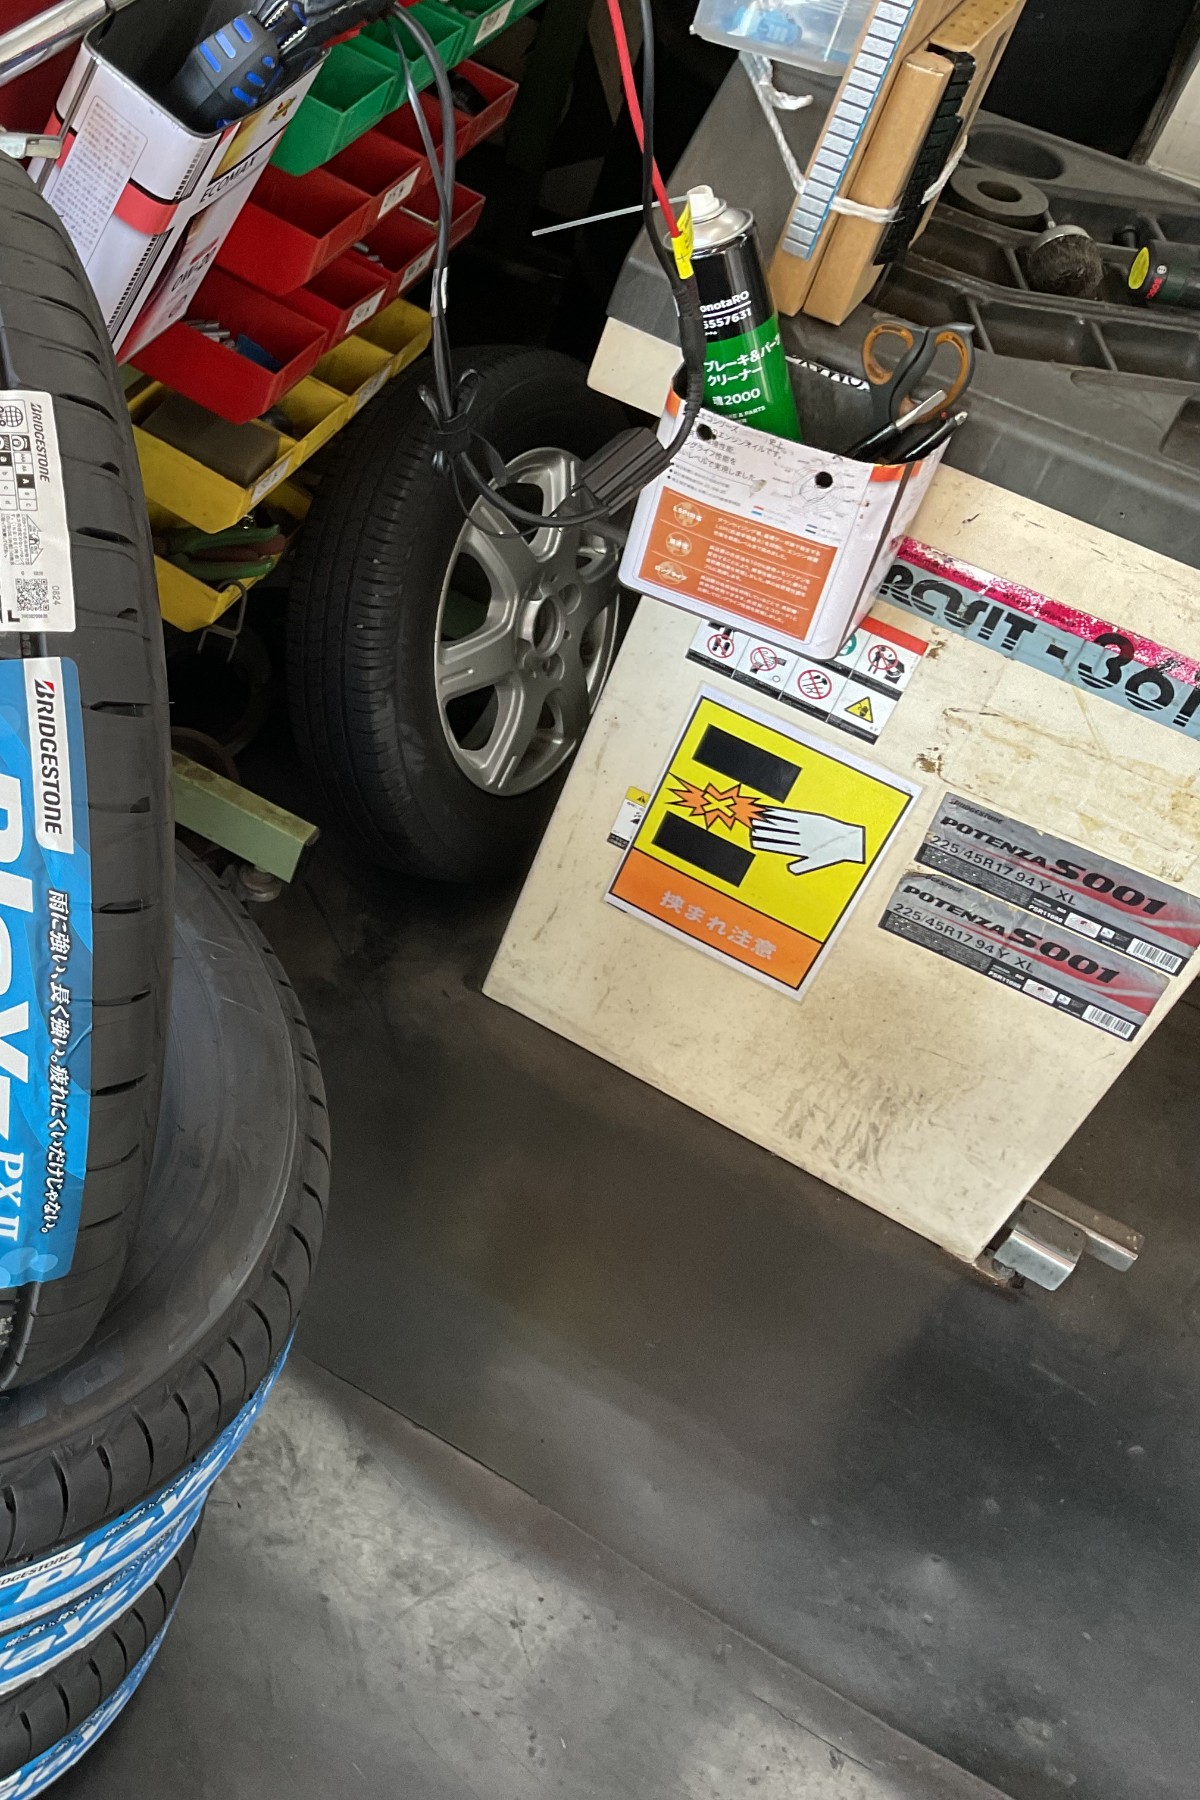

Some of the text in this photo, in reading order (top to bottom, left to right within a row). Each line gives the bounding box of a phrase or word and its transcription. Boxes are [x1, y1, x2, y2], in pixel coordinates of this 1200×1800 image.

[199, 156, 257, 204] ECOMAX
[700, 290, 750, 313] onotaRO
[706, 366, 763, 387] クリーナー
[29, 401, 50, 483] BRIDGESTONE
[51, 584, 61, 607] 0824
[34, 679, 63, 835] BRIDGESTONE
[949, 797, 1004, 825] BRIDGESTONE
[930, 835, 1014, 877] 225/45R17
[1055, 888, 1077, 906] XL
[940, 815, 1049, 869] POTENZA
[1048, 858, 1169, 917] S001
[659, 890, 777, 961] 挟まれ注意
[892, 903, 973, 944] 225/45R17
[1013, 956, 1034, 974] XL
[903, 884, 1007, 936] POTENZA
[1006, 927, 1122, 985] S001
